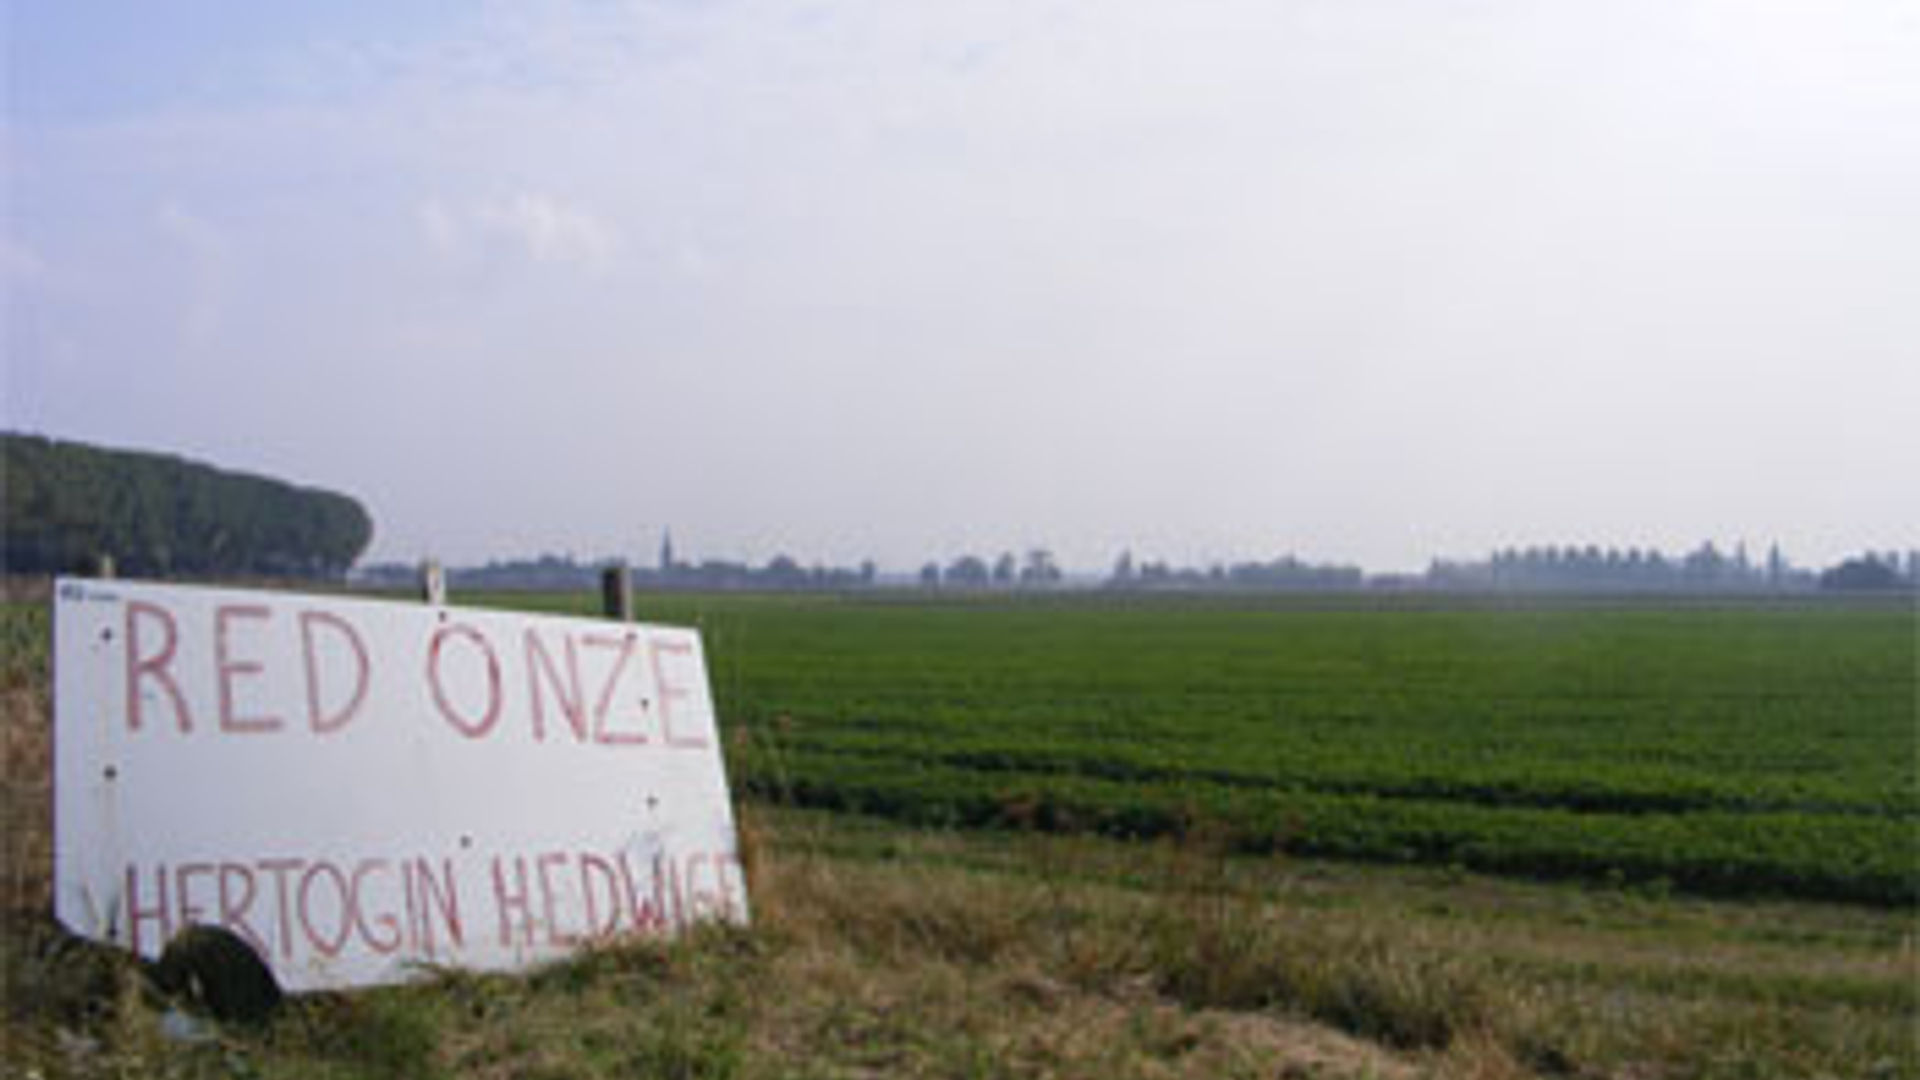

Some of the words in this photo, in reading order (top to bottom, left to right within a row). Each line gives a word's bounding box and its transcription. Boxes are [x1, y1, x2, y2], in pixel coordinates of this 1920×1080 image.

[125, 600, 370, 734] RED
[427, 624, 708, 749] ONZE
[125, 855, 463, 962] HERTOGIN
